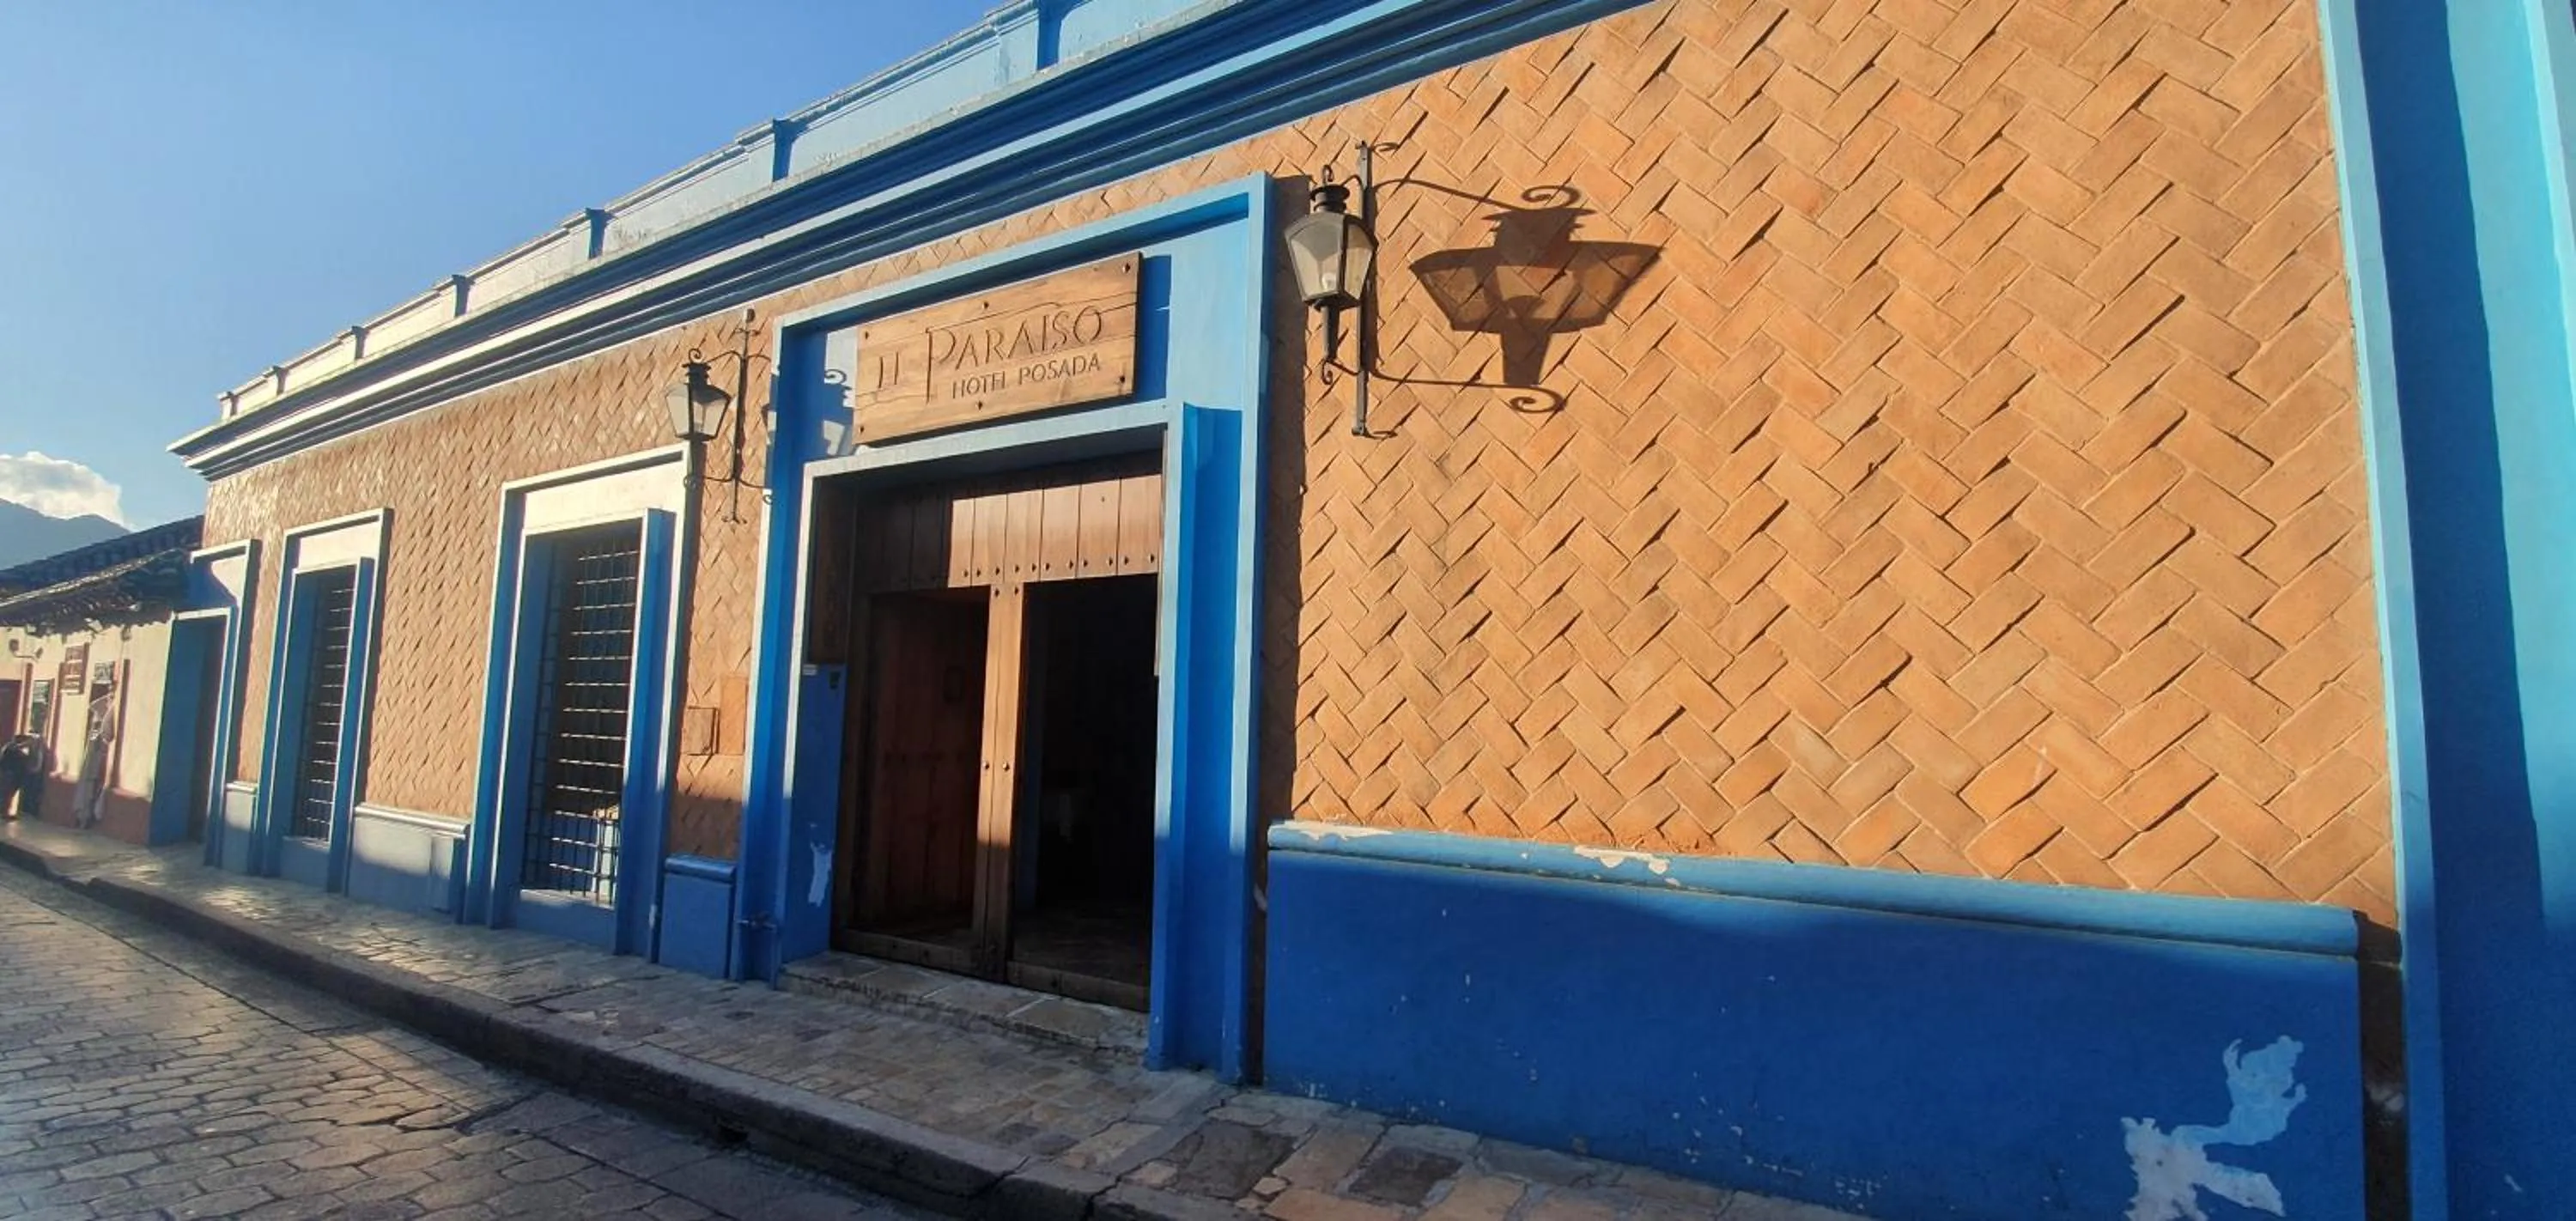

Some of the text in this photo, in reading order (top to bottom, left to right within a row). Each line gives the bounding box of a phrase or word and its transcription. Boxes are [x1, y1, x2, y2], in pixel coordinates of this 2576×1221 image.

[927, 304, 1103, 404] PARAISO
[952, 352, 1101, 398] HOTEL POSADA
